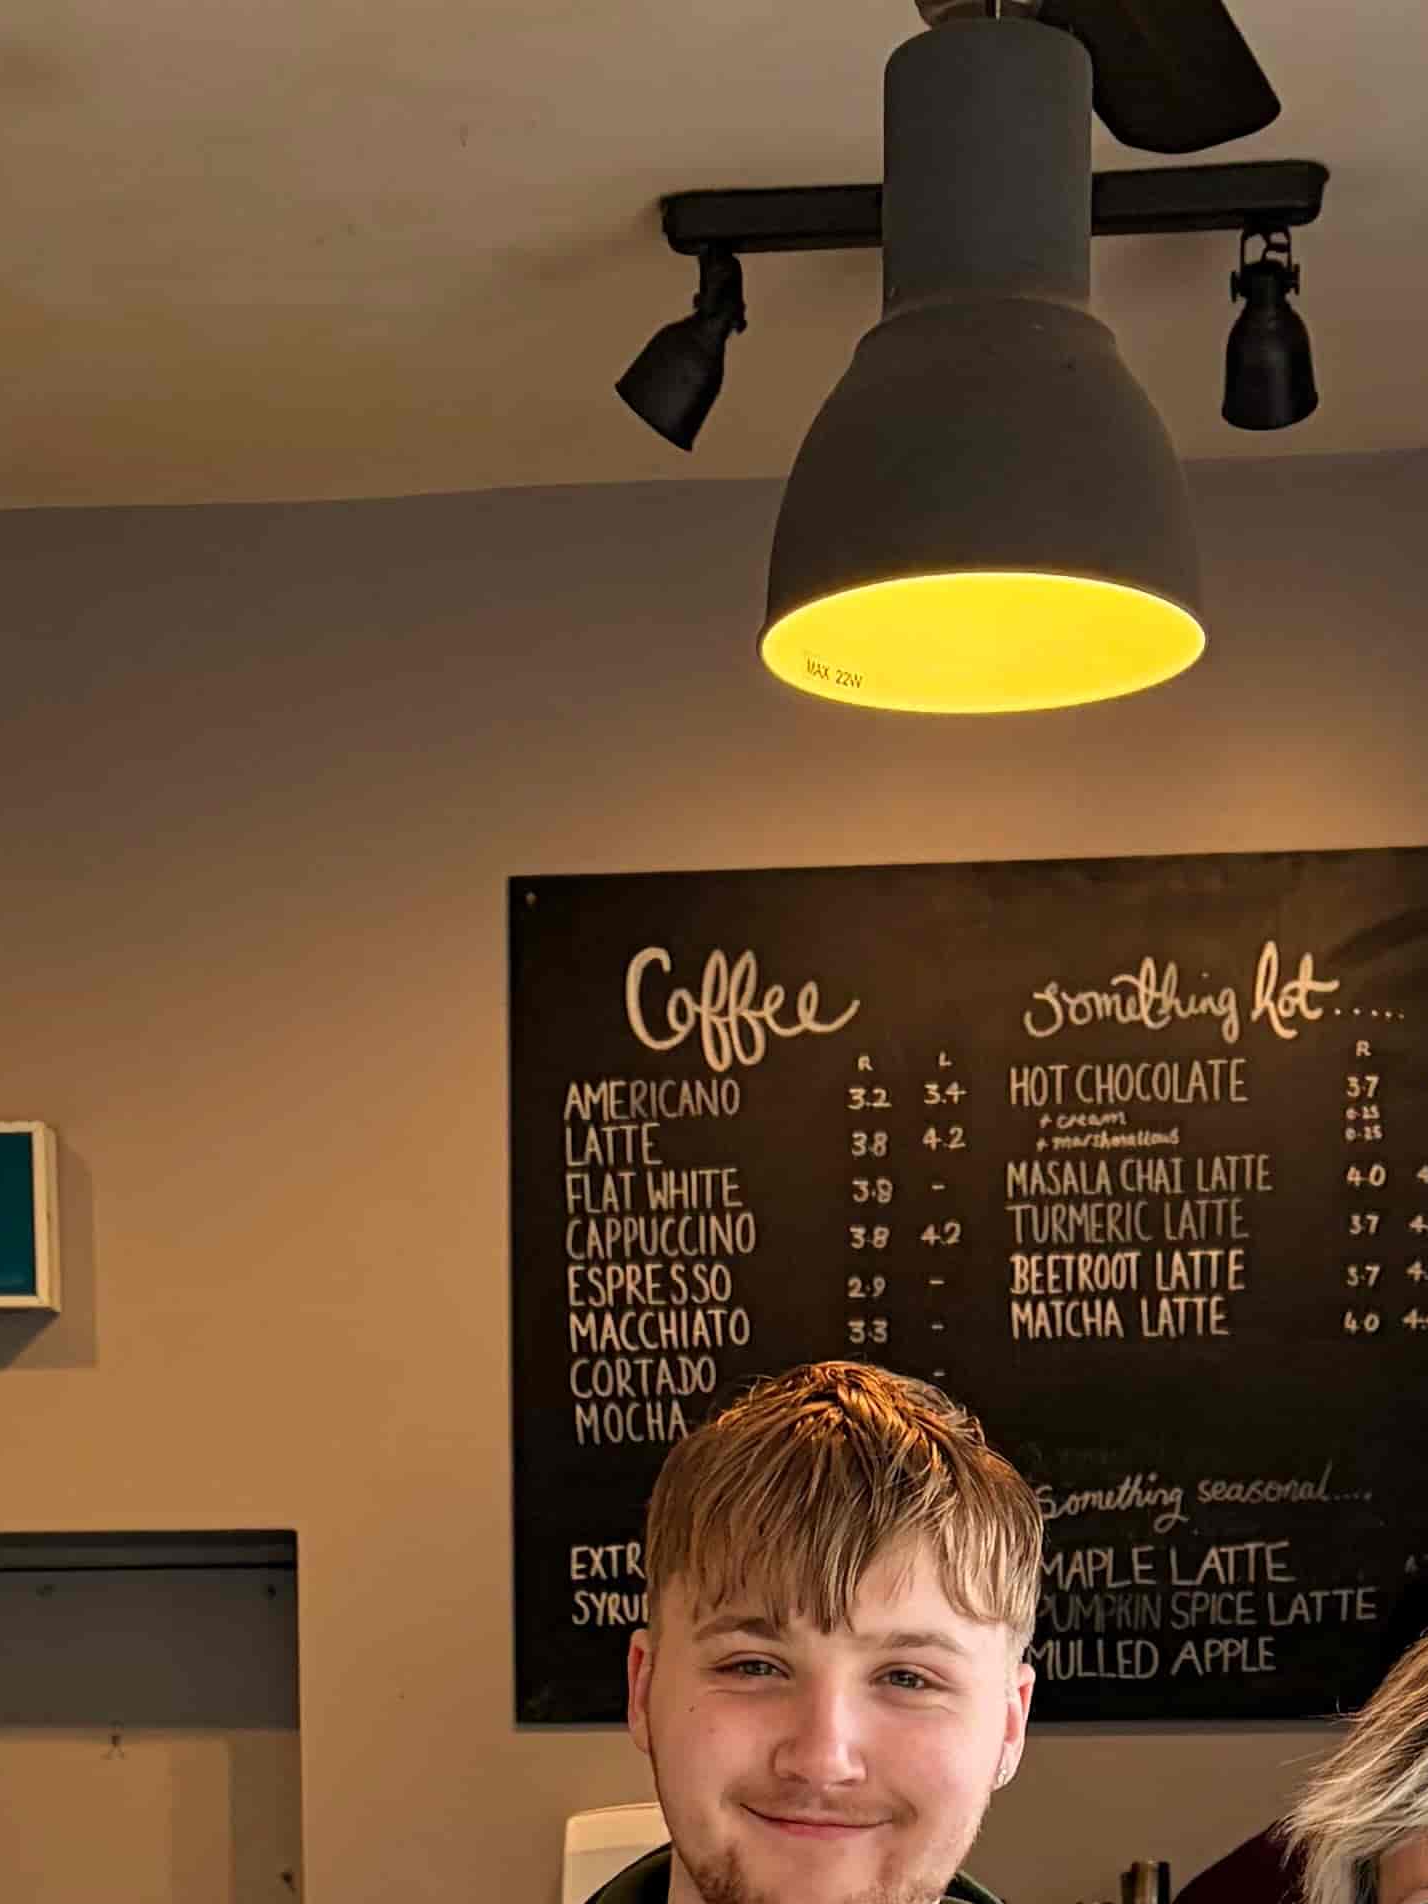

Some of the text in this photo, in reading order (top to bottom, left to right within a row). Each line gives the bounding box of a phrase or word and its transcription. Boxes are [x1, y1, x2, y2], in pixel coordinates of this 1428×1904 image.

[626, 947, 860, 1072] Coffee
[564, 1080, 967, 1121] AMERICANO 3.2 3.4
[1010, 1066, 1069, 1106] HOT
[1076, 1058, 1248, 1104] CHOCOLATE
[565, 1122, 662, 1167] LATTE
[922, 1126, 967, 1150] 4.2
[566, 1173, 636, 1214] FLAT
[648, 1168, 742, 1209] WHITE
[1006, 1157, 1113, 1198] MASALA
[1120, 1155, 1185, 1195] CHAI
[1197, 1153, 1272, 1193] LATTE
[565, 1213, 756, 1262] CAPPUCCINO
[1005, 1202, 1153, 1245] TURMERIC
[1164, 1198, 1249, 1241] LATTE
[567, 1264, 886, 1307] ESPRESSO 2.9
[1009, 1252, 1141, 1294] BEETROOT
[1155, 1250, 1245, 1292] LATTE
[570, 1309, 749, 1352] MACCHIATO
[1010, 1300, 1124, 1339] MATCHA
[1142, 1297, 1229, 1337] LATTE
[571, 1357, 716, 1398] CORTADO
[575, 1404, 687, 1445] MOCHA
[570, 1541, 647, 1580] EXTR
[1039, 1541, 1297, 1592] MAPLE LATTE
[1171, 1590, 1257, 1631] SPICE
[1268, 1586, 1378, 1627] LATTE
[1027, 1636, 1277, 1680] MULLED APPLE
